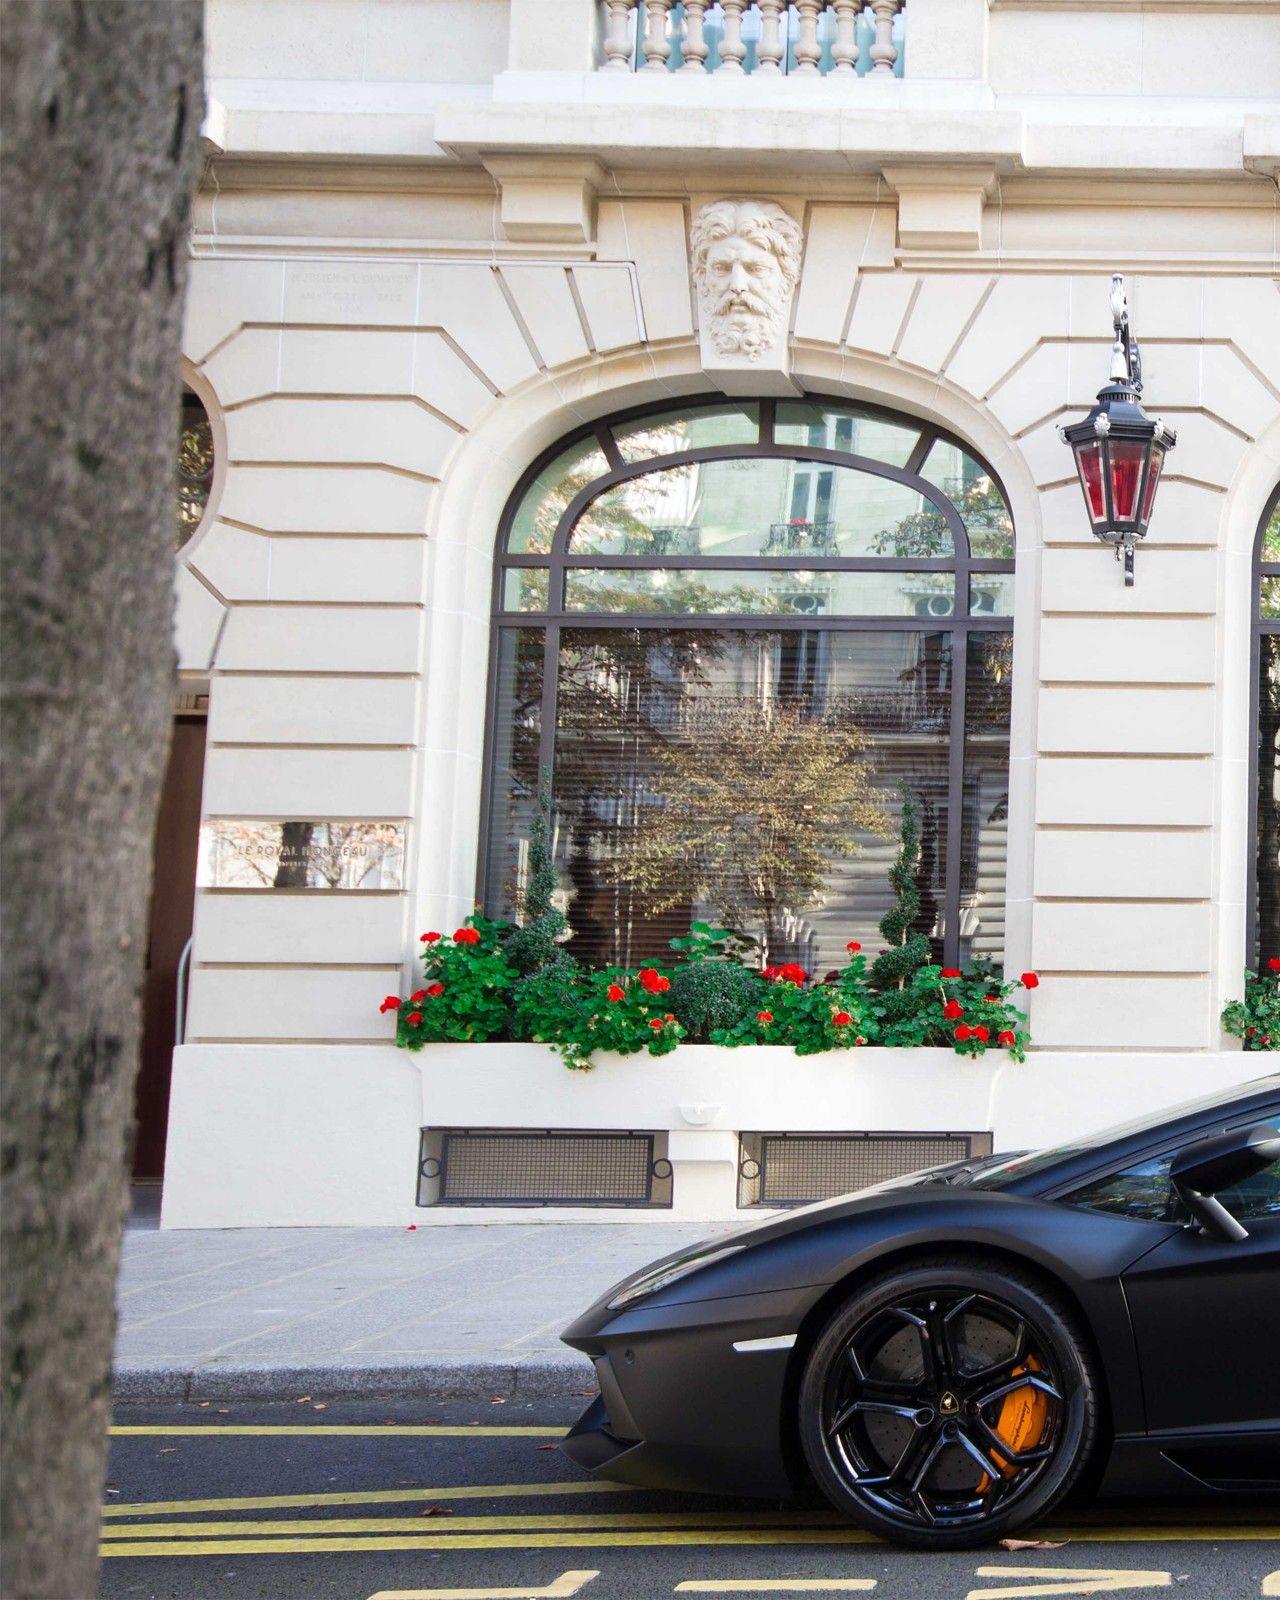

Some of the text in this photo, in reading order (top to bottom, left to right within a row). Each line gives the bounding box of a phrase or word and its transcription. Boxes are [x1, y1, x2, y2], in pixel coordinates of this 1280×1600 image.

[238, 845, 368, 857] LE ROYAL MONCEAU
